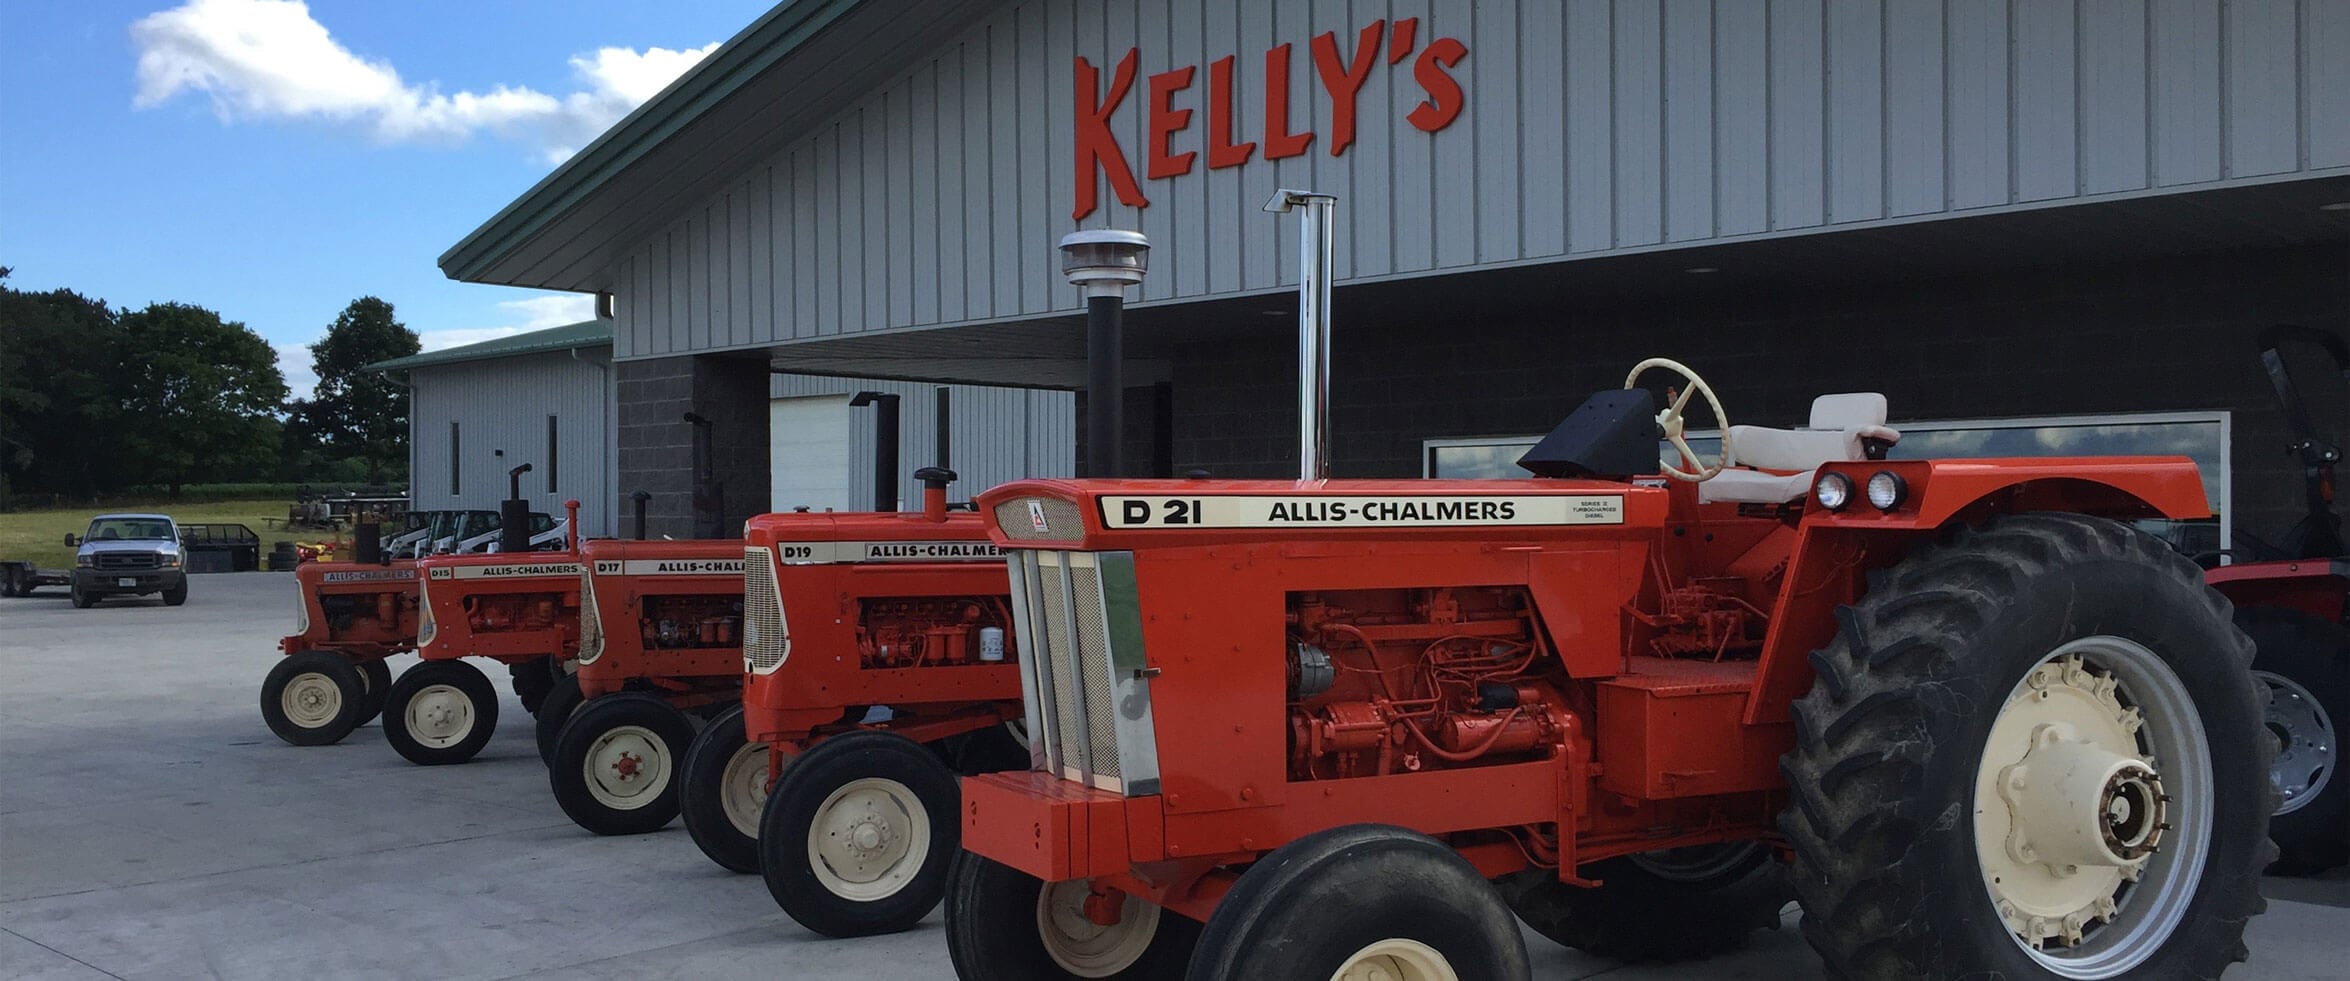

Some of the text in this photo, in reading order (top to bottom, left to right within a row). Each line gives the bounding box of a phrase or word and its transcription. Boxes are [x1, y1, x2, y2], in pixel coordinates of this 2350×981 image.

[1123, 499, 1201, 525] D 21
[1268, 501, 1515, 521] ALLIS-CHALMERS
[784, 546, 812, 558] D19
[431, 569, 450, 577] D15
[483, 564, 578, 576] ALLIS-CHALMERS
[599, 563, 620, 573] D17
